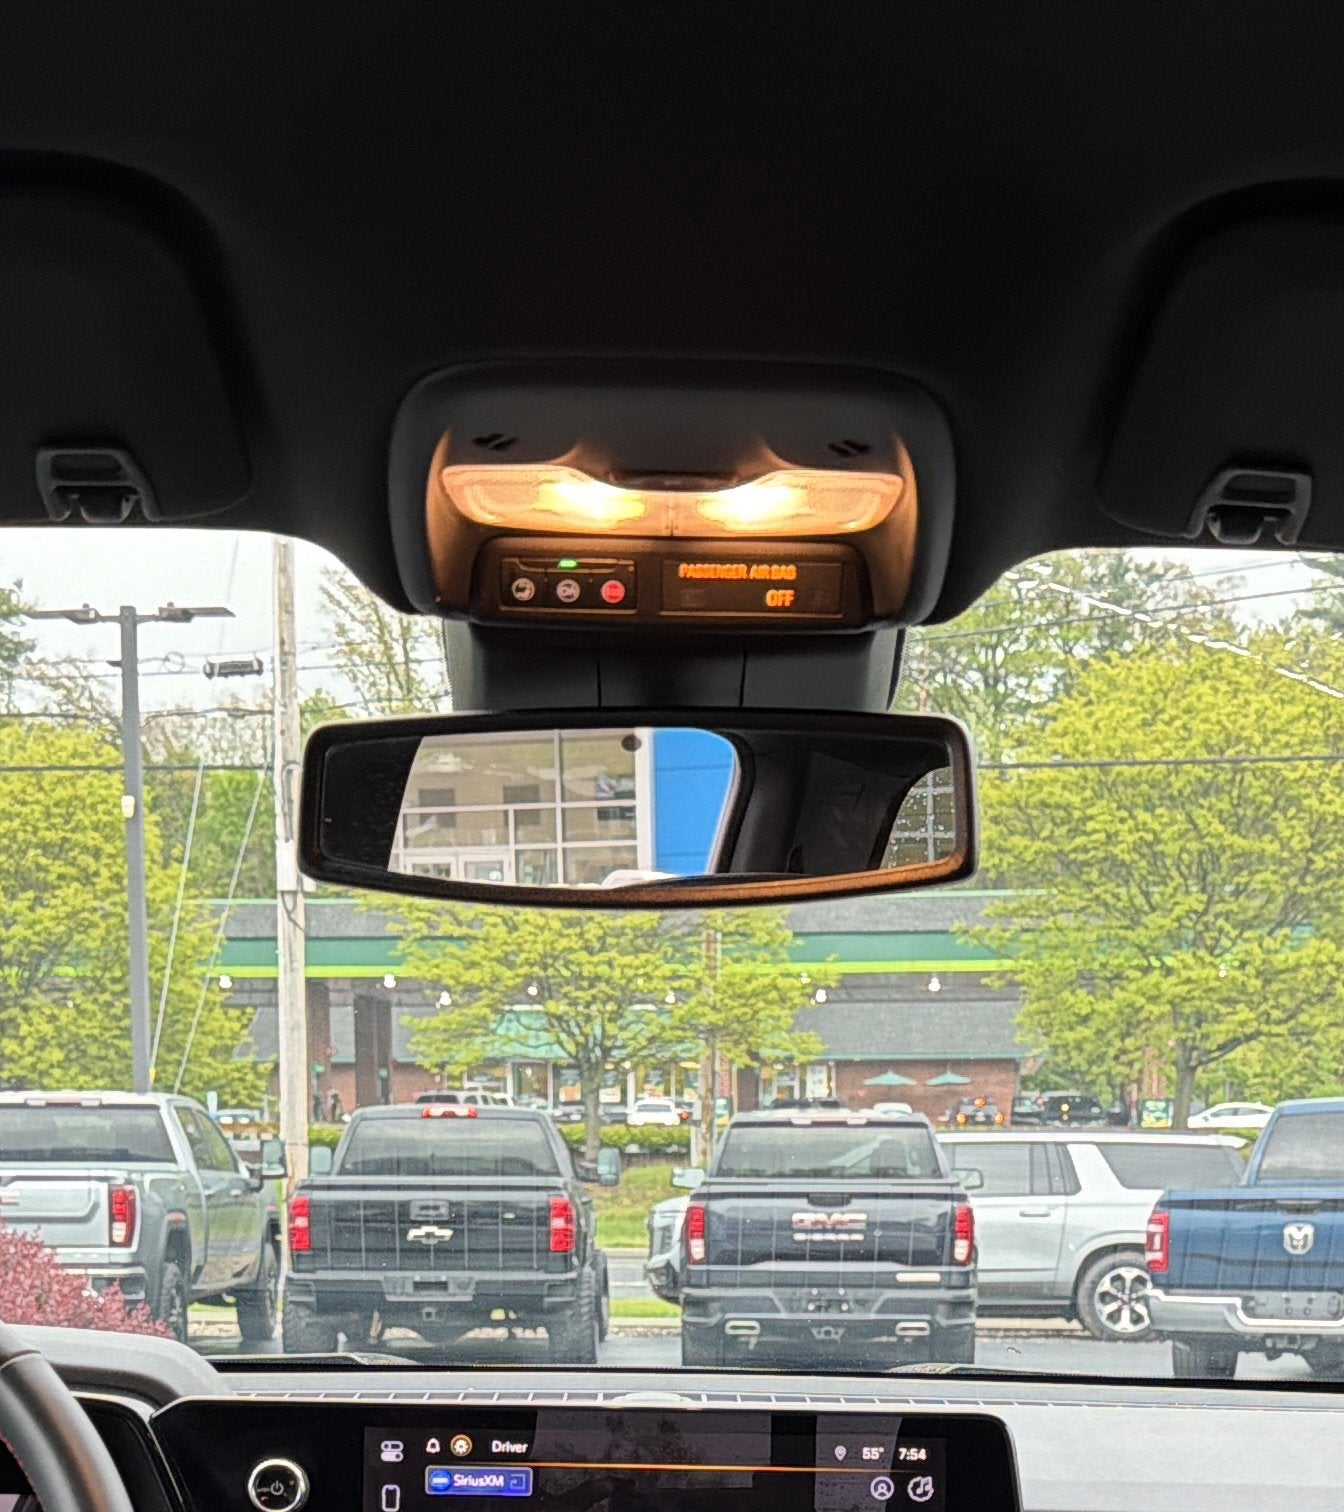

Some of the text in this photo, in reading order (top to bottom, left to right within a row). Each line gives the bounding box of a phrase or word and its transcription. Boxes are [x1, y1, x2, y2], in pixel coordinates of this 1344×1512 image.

[678, 563, 797, 580] PASSENGER AIR BAG
[766, 589, 795, 607] OFF
[792, 1212, 868, 1230] GMC
[491, 1440, 528, 1454] Driver
[899, 1447, 927, 1461] 7:54
[453, 1474, 505, 1489] SiriusXM
